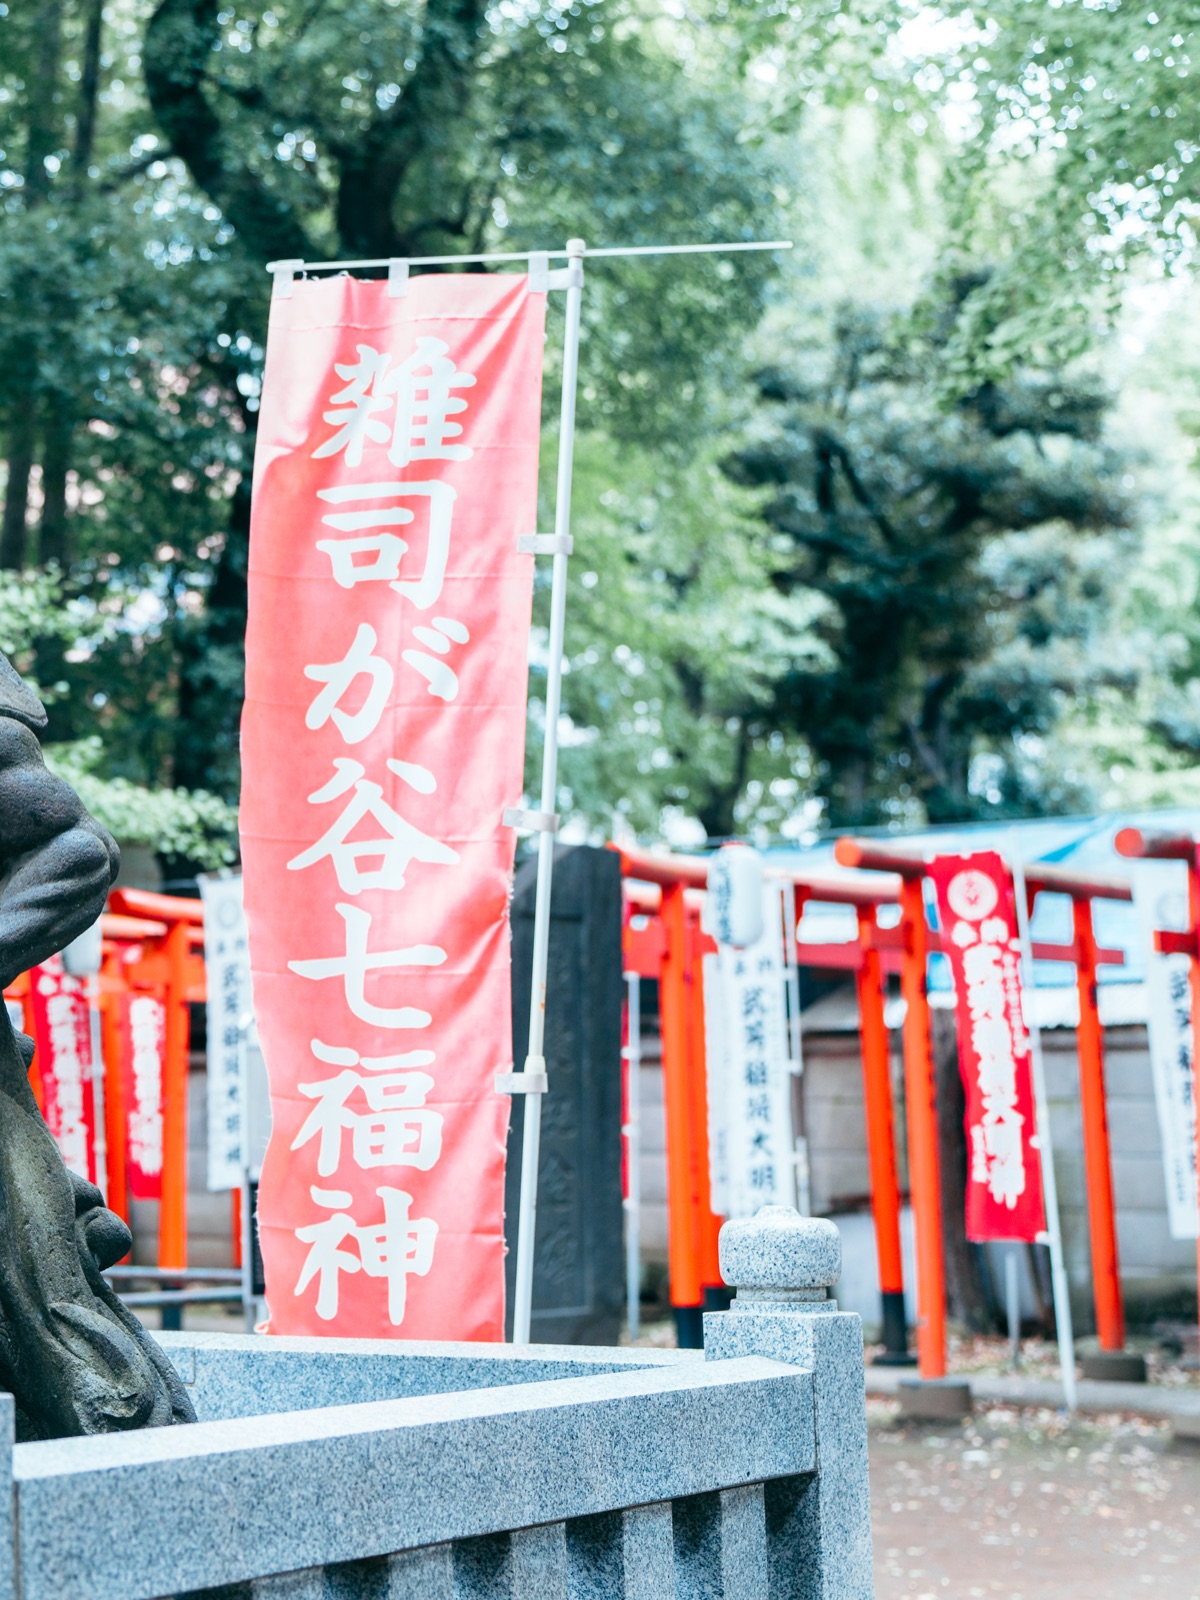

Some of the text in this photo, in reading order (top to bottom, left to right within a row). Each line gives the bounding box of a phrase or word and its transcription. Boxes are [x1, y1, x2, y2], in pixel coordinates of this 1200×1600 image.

[287, 336, 477, 1325] 雑司が谷七福神
